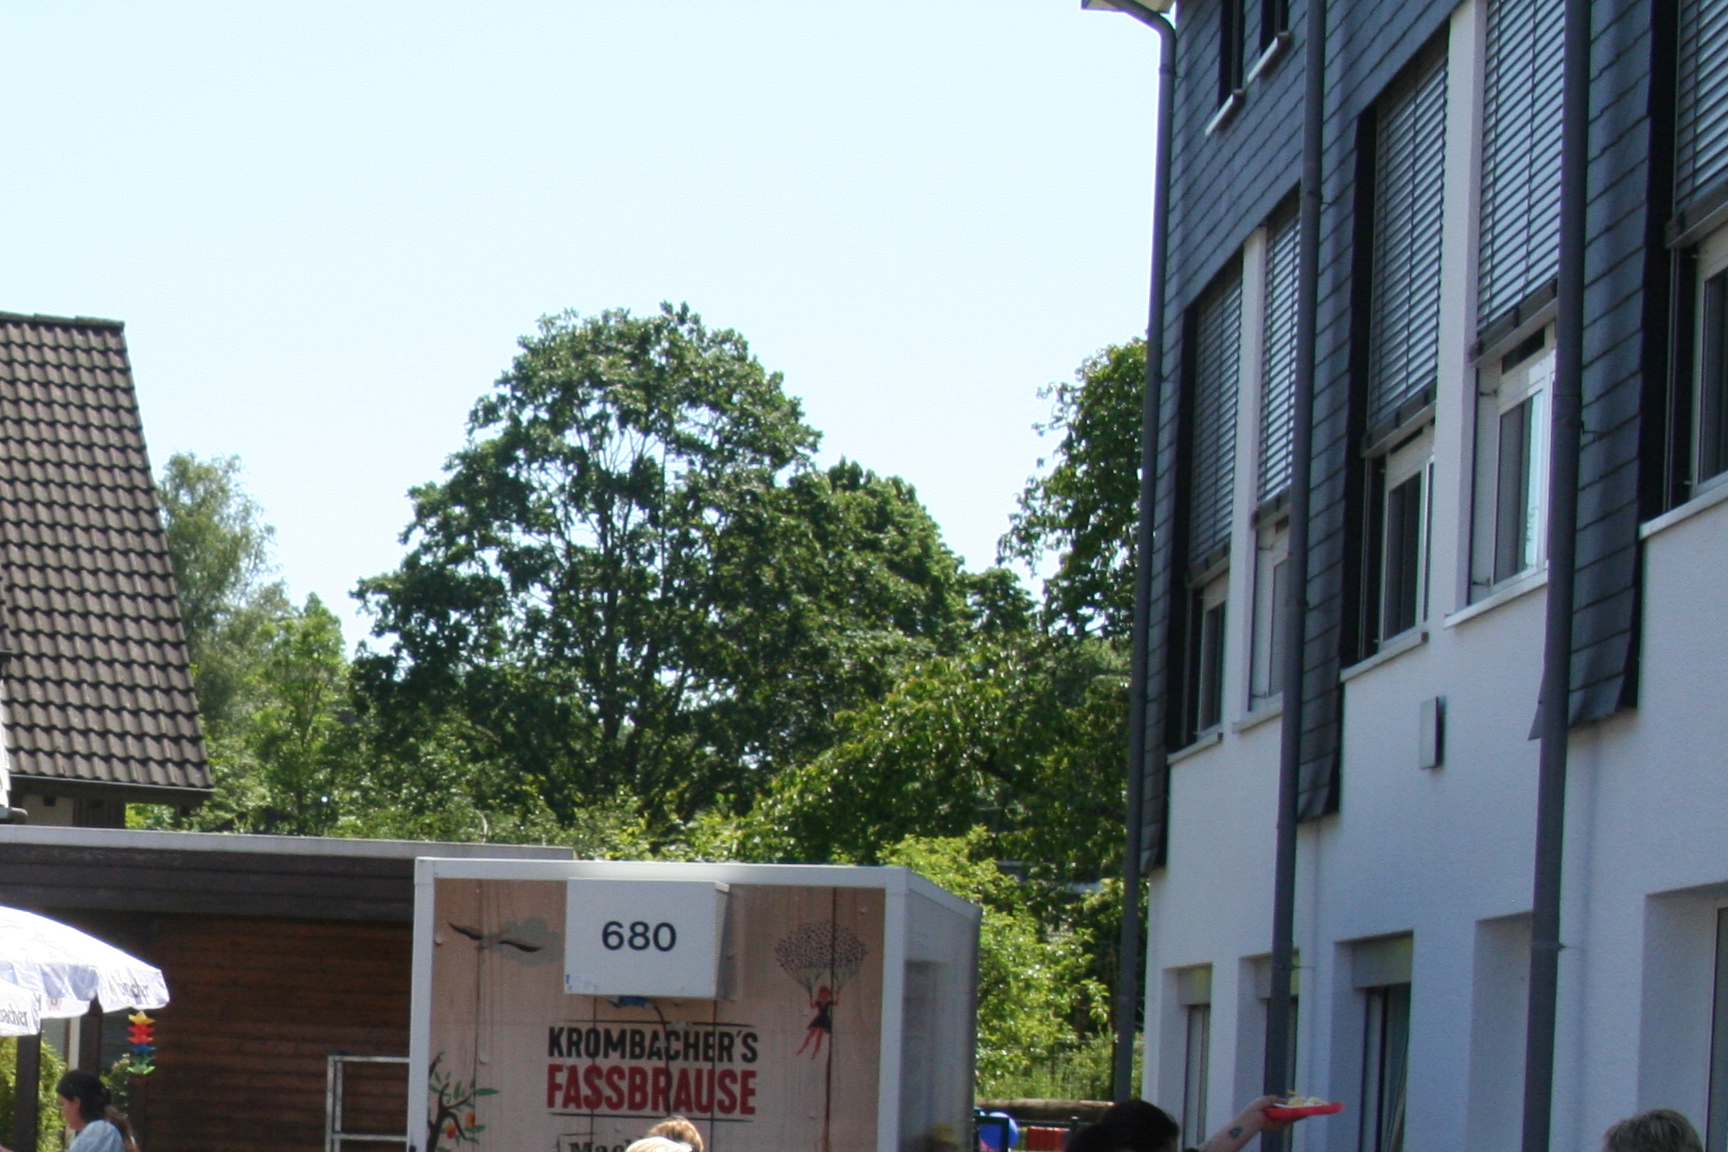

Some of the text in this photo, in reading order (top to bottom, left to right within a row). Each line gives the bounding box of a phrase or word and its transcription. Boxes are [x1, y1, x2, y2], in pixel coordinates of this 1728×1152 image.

[601, 920, 677, 952] 680
[548, 1026, 759, 1063] KROMBACHER'S
[546, 1063, 757, 1115] FASSBRAUSE
